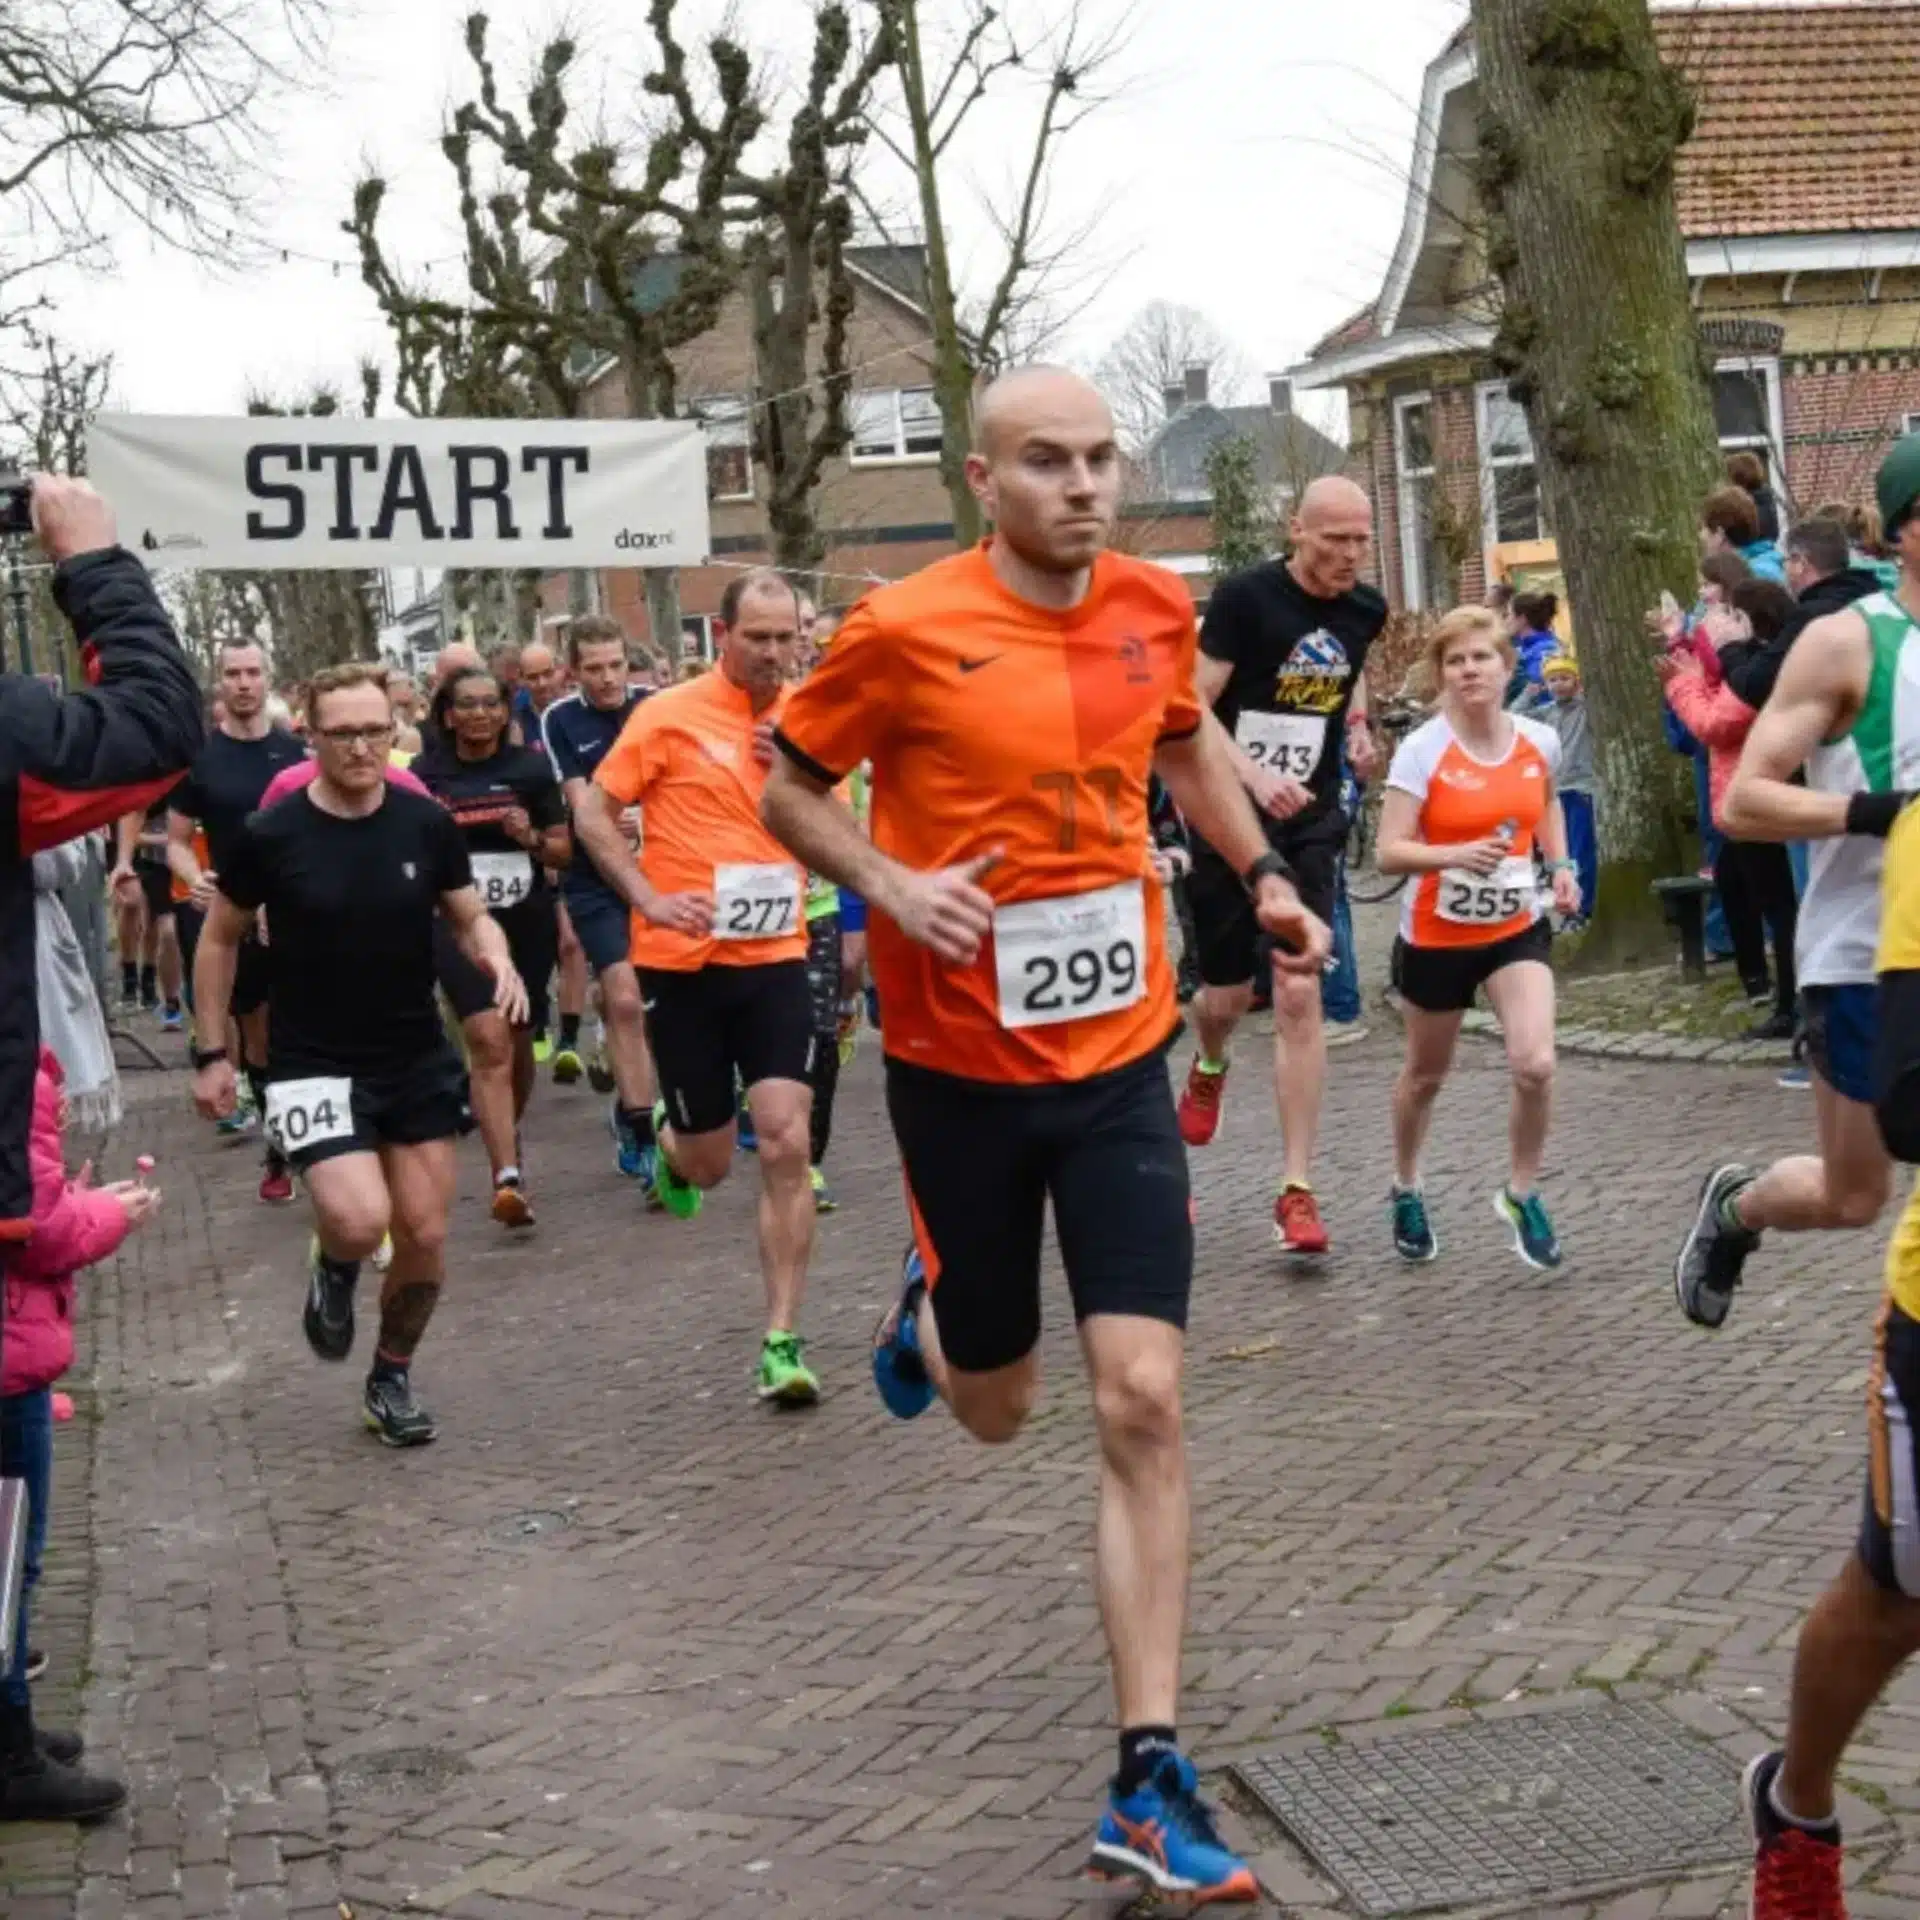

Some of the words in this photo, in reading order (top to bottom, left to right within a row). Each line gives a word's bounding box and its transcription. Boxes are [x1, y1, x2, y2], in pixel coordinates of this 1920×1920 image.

[246, 443, 590, 540] START
[1249, 741, 1312, 776] 243
[475, 877, 522, 902] 84
[1449, 884, 1520, 917] 255
[728, 896, 792, 931] 277
[1023, 939, 1136, 1011] 299
